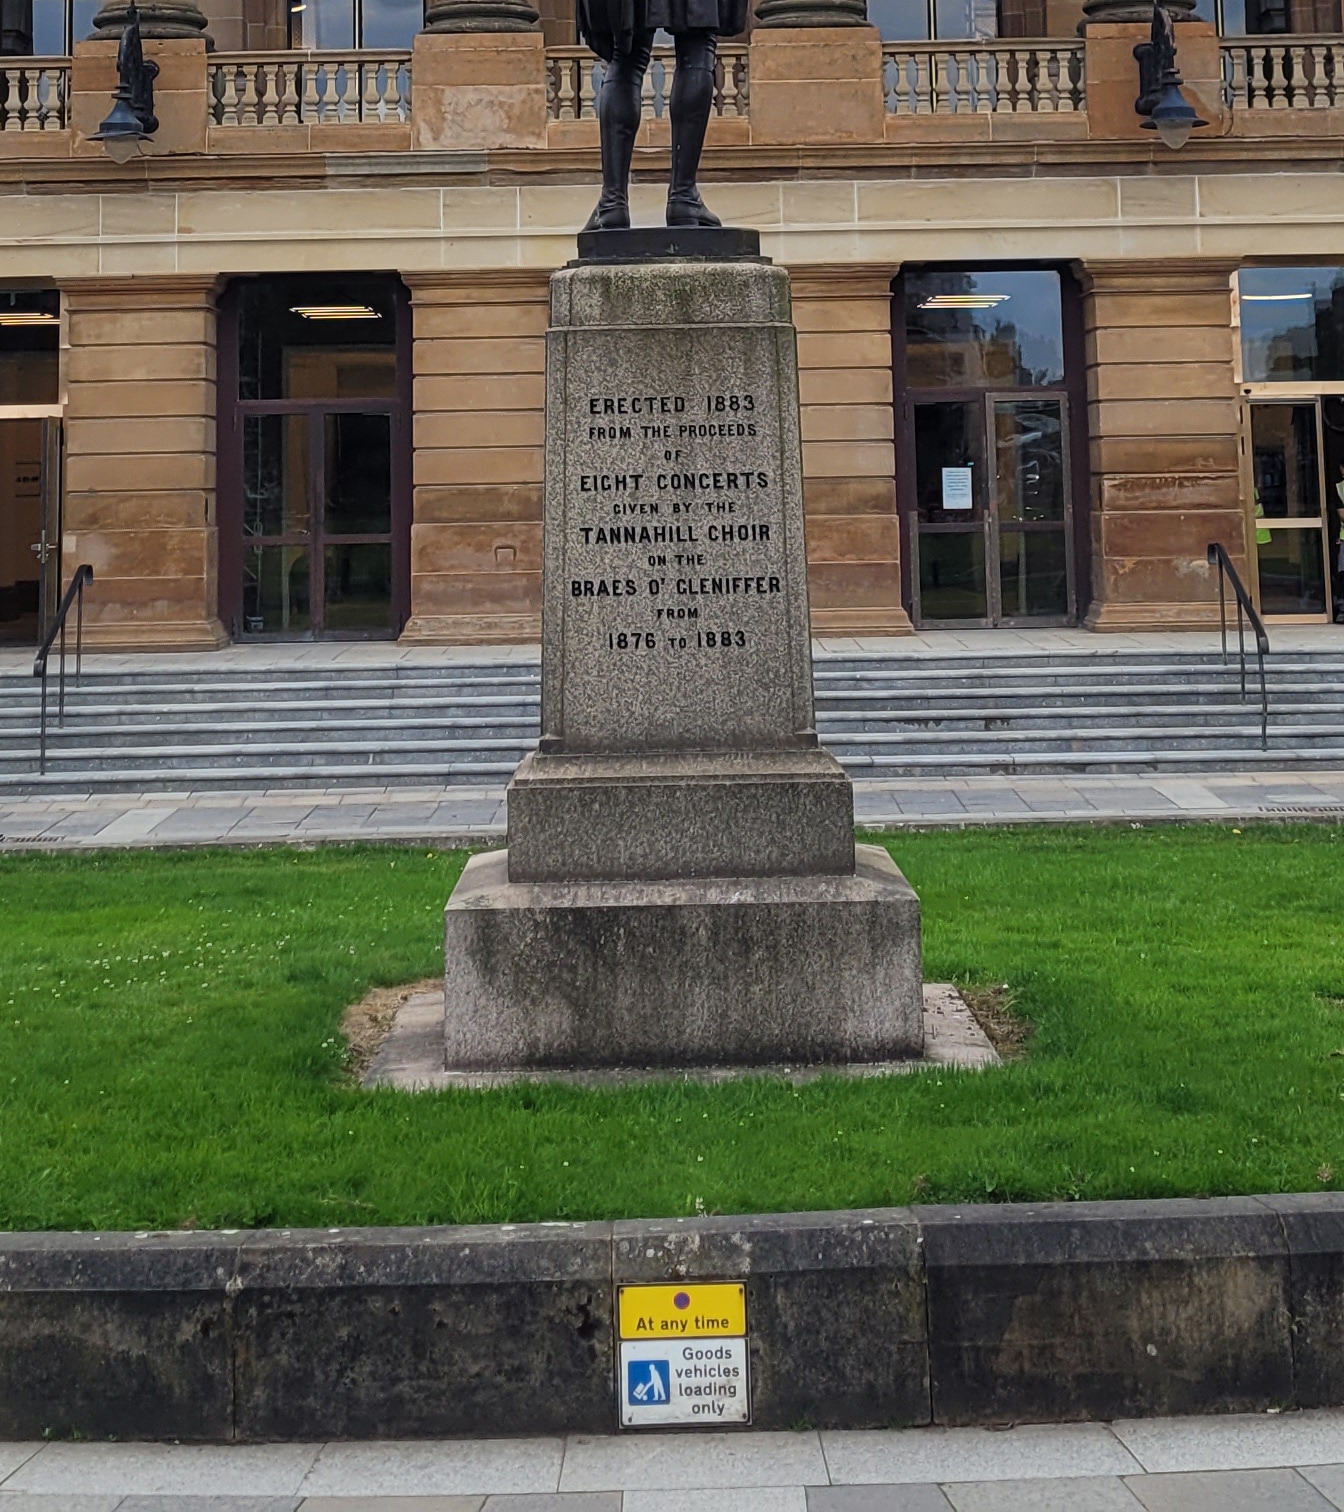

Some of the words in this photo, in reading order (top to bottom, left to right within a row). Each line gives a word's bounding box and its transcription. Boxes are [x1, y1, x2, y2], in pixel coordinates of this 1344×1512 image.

[589, 396, 685, 414] ERECTED
[706, 394, 755, 413] 1883
[588, 426, 632, 439] FROM
[640, 425, 671, 438] THE
[679, 423, 757, 437] PROCEEDS
[664, 449, 682, 461] OF
[580, 474, 643, 492] EIGHT
[657, 472, 768, 489] CONCERTS
[613, 503, 659, 515] GIVEN
[672, 502, 692, 513] BY
[705, 501, 736, 513] THE
[579, 525, 699, 545] TANNAHILL
[708, 524, 771, 542] CHOIR
[648, 555, 666, 566] ON
[674, 554, 705, 565] THE
[571, 579, 637, 597] BRAES
[676, 576, 781, 595] GLENIFFER
[656, 607, 699, 619] FROM
[608, 632, 656, 649] 1876
[668, 637, 687, 649] TO
[697, 630, 746, 648] 1883
[636, 1317, 654, 1331] At
[660, 1318, 688, 1333] any
[694, 1315, 729, 1330] time
[682, 1346, 732, 1361] Goods
[675, 1364, 740, 1379] vehicles
[679, 1382, 737, 1398] loading
[692, 1400, 725, 1416] only
